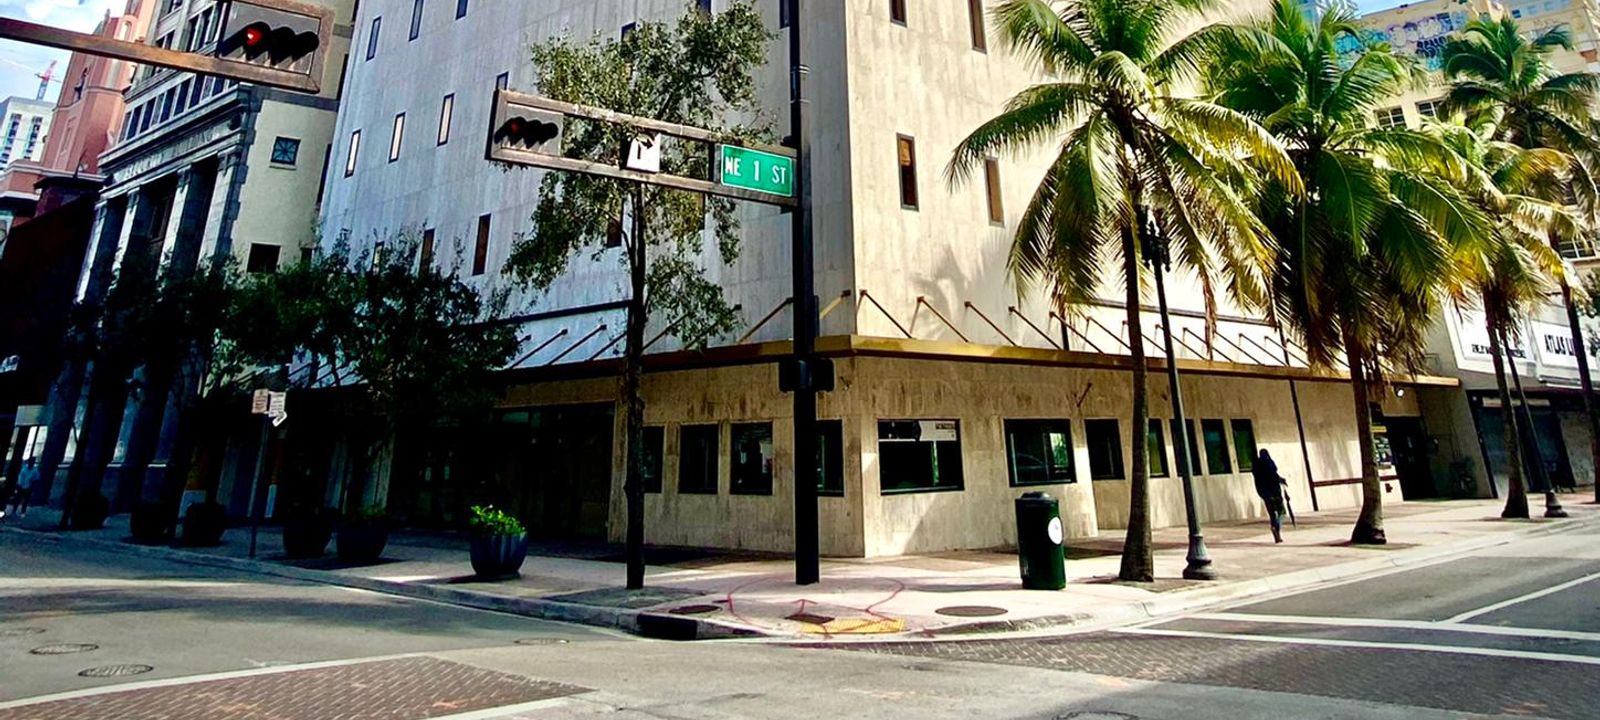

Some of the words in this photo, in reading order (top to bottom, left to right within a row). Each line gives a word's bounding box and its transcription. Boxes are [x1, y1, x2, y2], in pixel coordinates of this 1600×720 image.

[725, 156, 741, 176] NE
[753, 160, 760, 182] 1
[772, 165, 786, 184] ST
[1544, 334, 1566, 355] ATLAS
